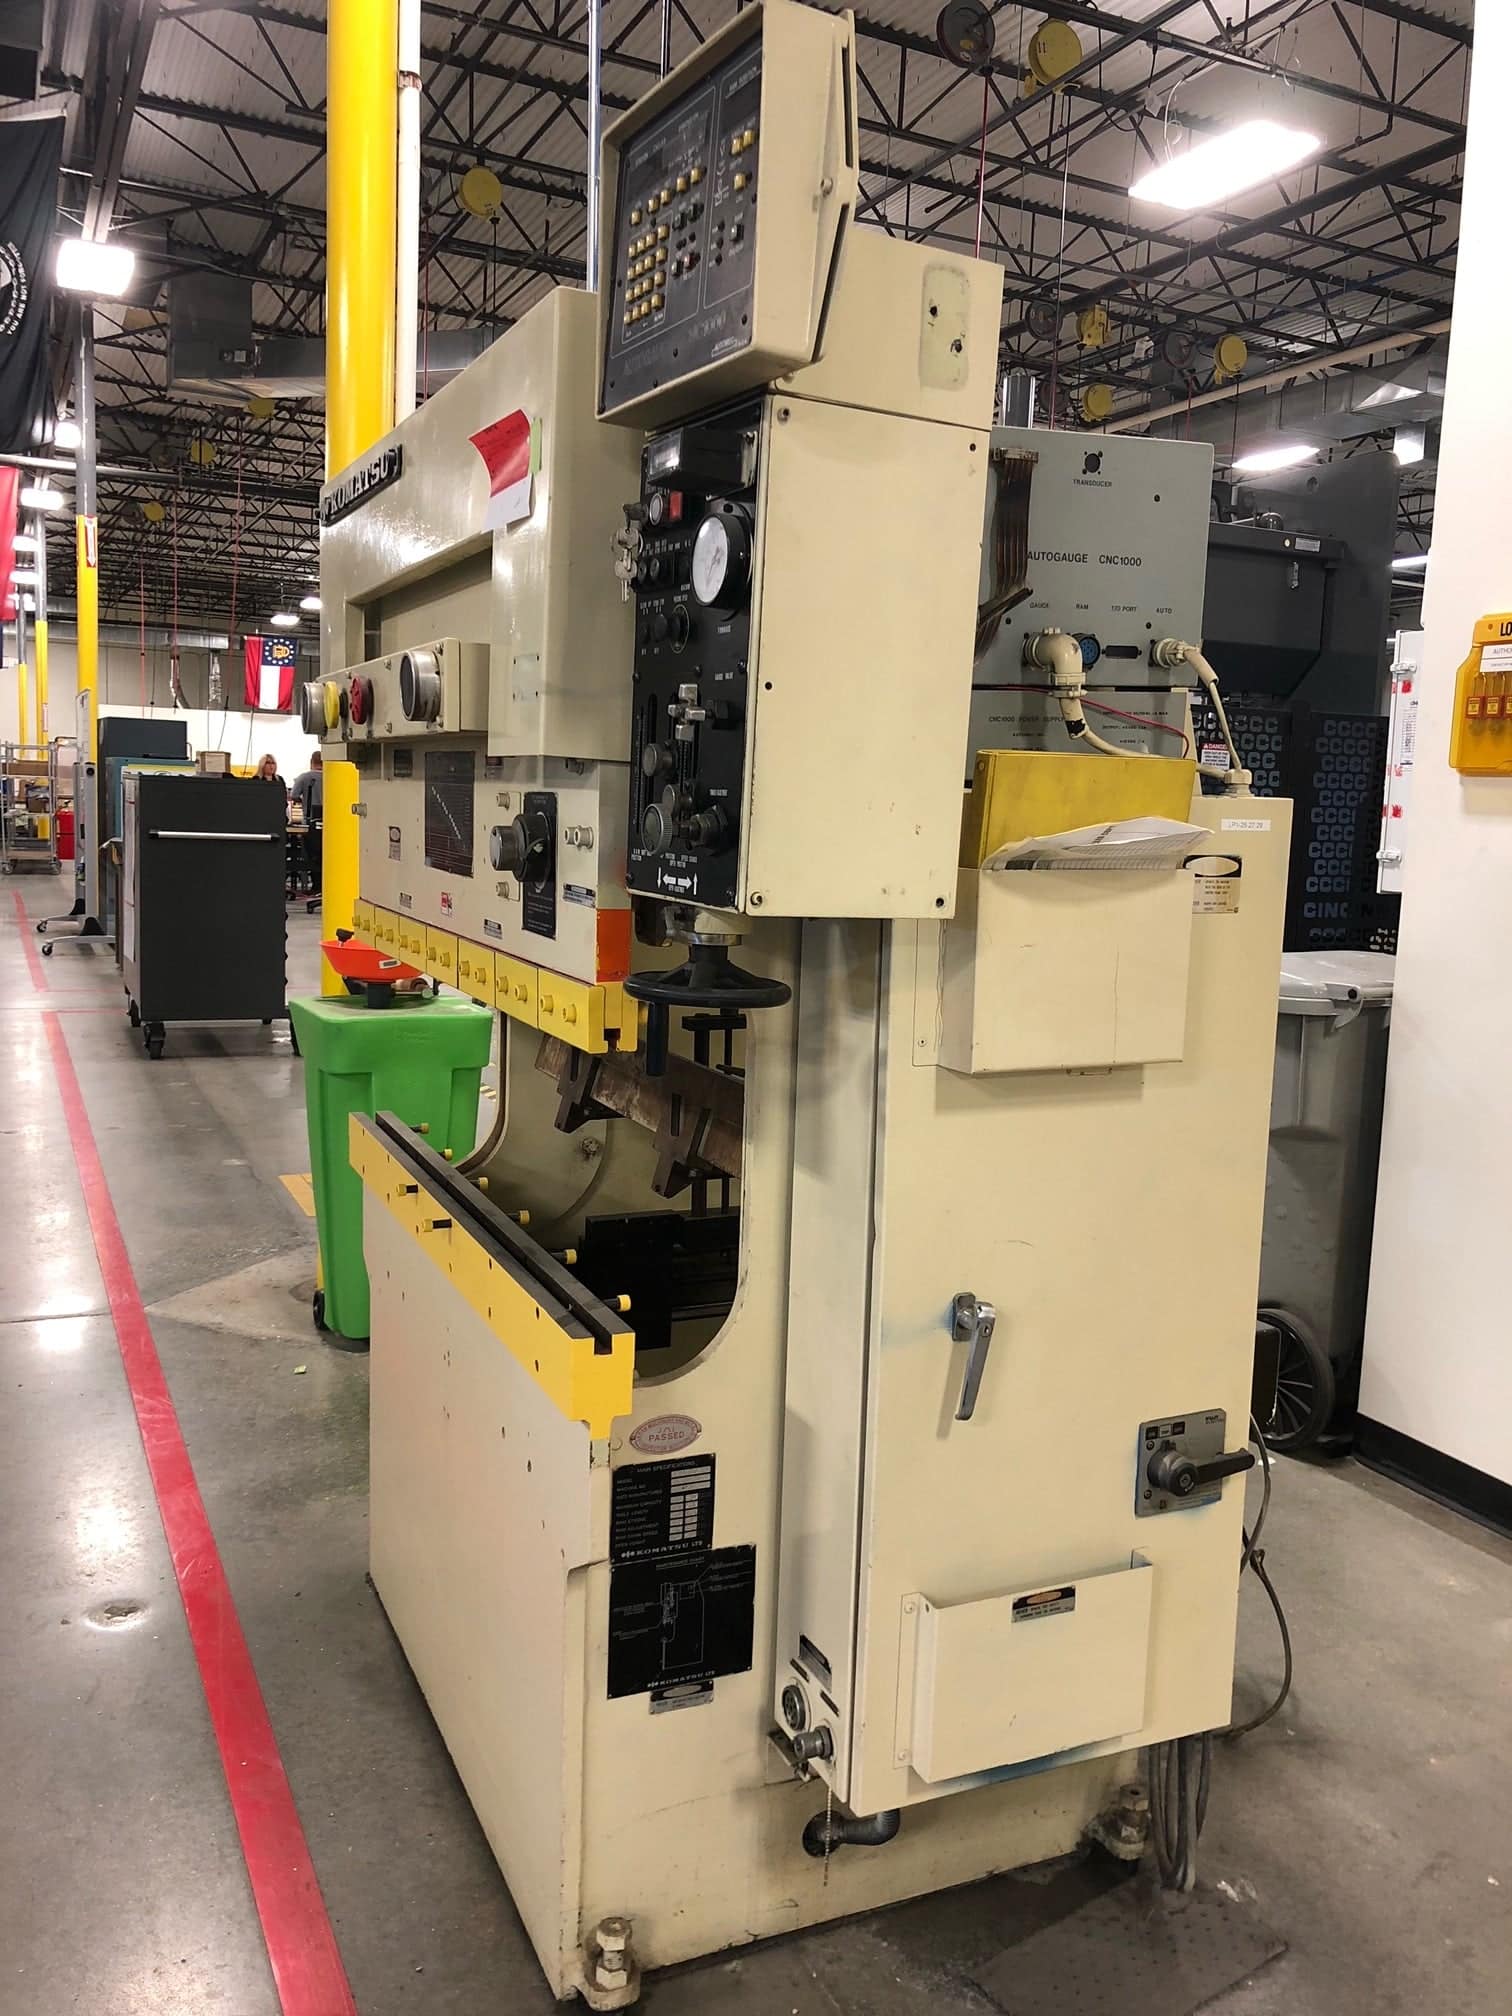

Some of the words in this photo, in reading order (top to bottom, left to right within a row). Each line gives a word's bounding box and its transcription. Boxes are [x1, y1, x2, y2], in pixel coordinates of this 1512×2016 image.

[20, 285, 28, 301] NOT
[16, 303, 26, 319] ARE
[7, 319, 20, 335] YOU
[331, 452, 389, 514] KOMATSU
[1072, 479, 1112, 488] TRANSDUCER
[1028, 551, 1088, 563] AUTOGAUGE
[1098, 554, 1142, 567] CNC1000
[648, 1431, 685, 1442] PASSED
[636, 1542, 689, 1556] KOMATSU
